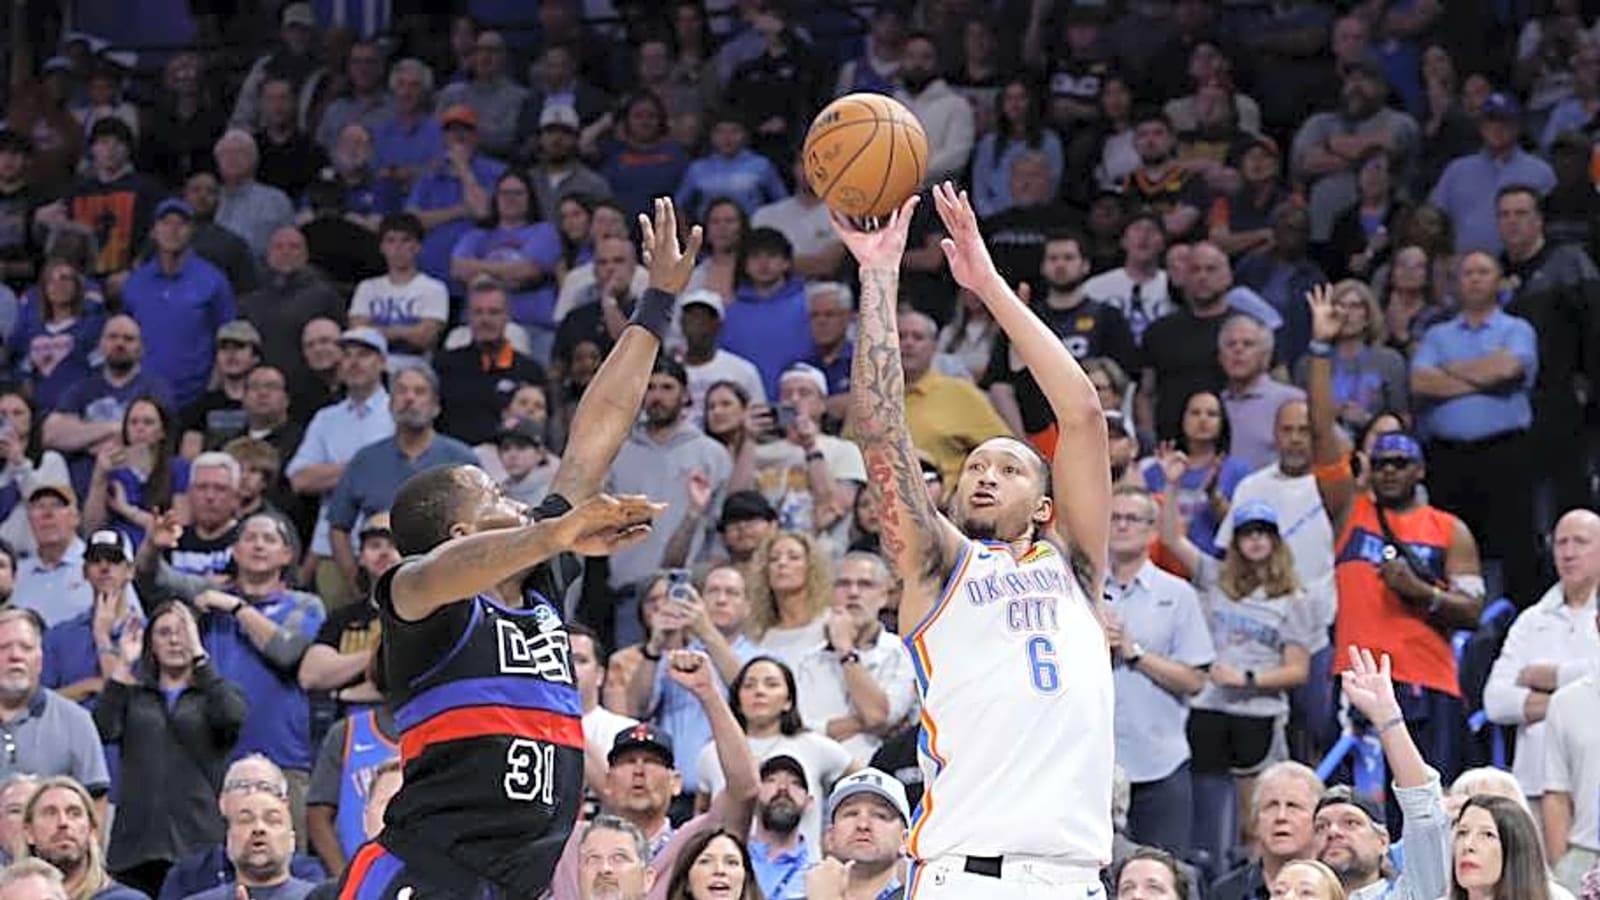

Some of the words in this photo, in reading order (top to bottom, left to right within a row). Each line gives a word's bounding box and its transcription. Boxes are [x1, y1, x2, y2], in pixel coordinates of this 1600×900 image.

[965, 567, 1074, 606] OKAOM
[1008, 597, 1059, 632] CITY
[1027, 635, 1061, 694] 6
[504, 739, 555, 805] 31
